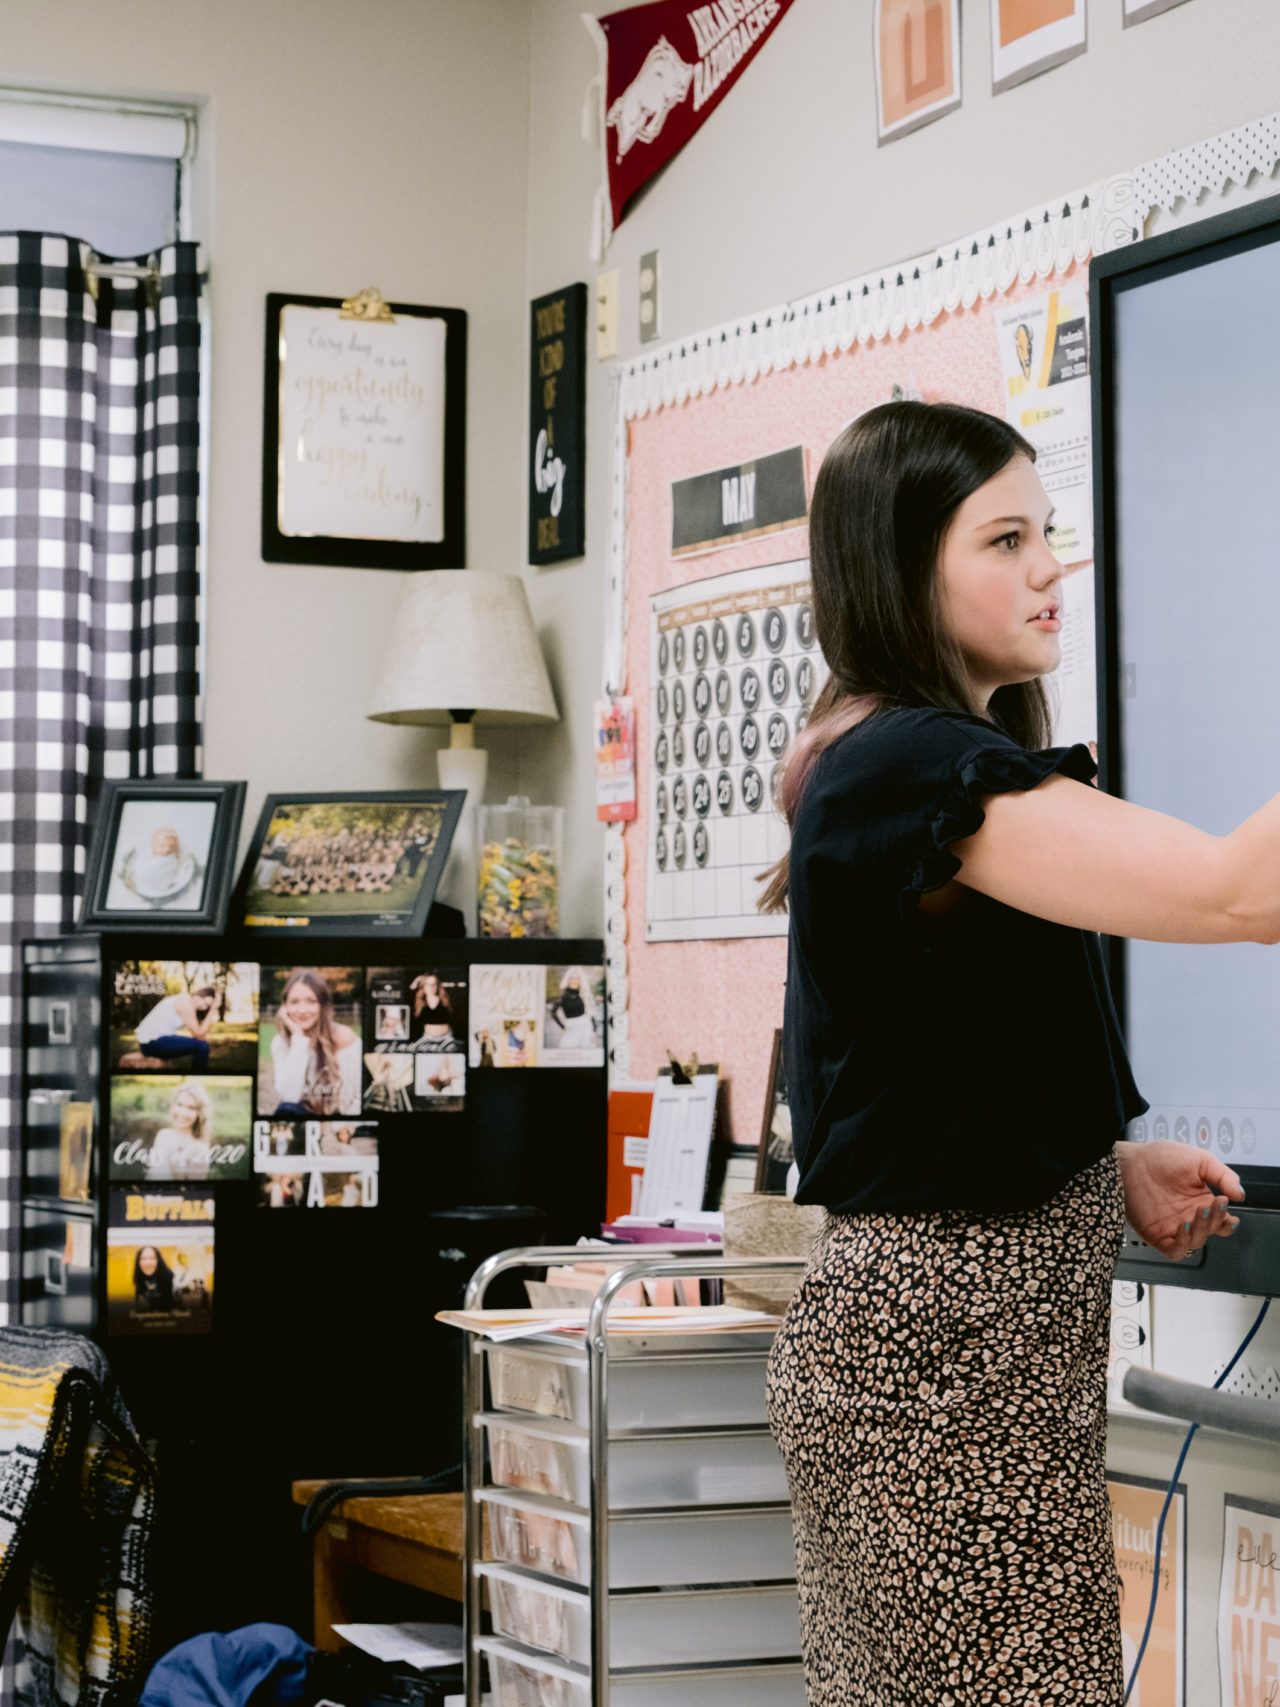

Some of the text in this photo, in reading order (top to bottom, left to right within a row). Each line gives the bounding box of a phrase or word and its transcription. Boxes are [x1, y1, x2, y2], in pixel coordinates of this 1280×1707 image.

[535, 428, 567, 518] big
[721, 472, 756, 526] MAY
[696, 635, 705, 661] 3
[716, 628, 724, 652] 4
[741, 622, 750, 647] 5
[769, 616, 780, 642] 6
[743, 677, 757, 702] 12
[771, 667, 785, 694] 13
[799, 665, 811, 695] 14
[743, 724, 757, 749] 19
[770, 722, 786, 748] 20
[695, 782, 709, 809] 24
[718, 780, 731, 804] 25
[744, 772, 760, 803] 26
